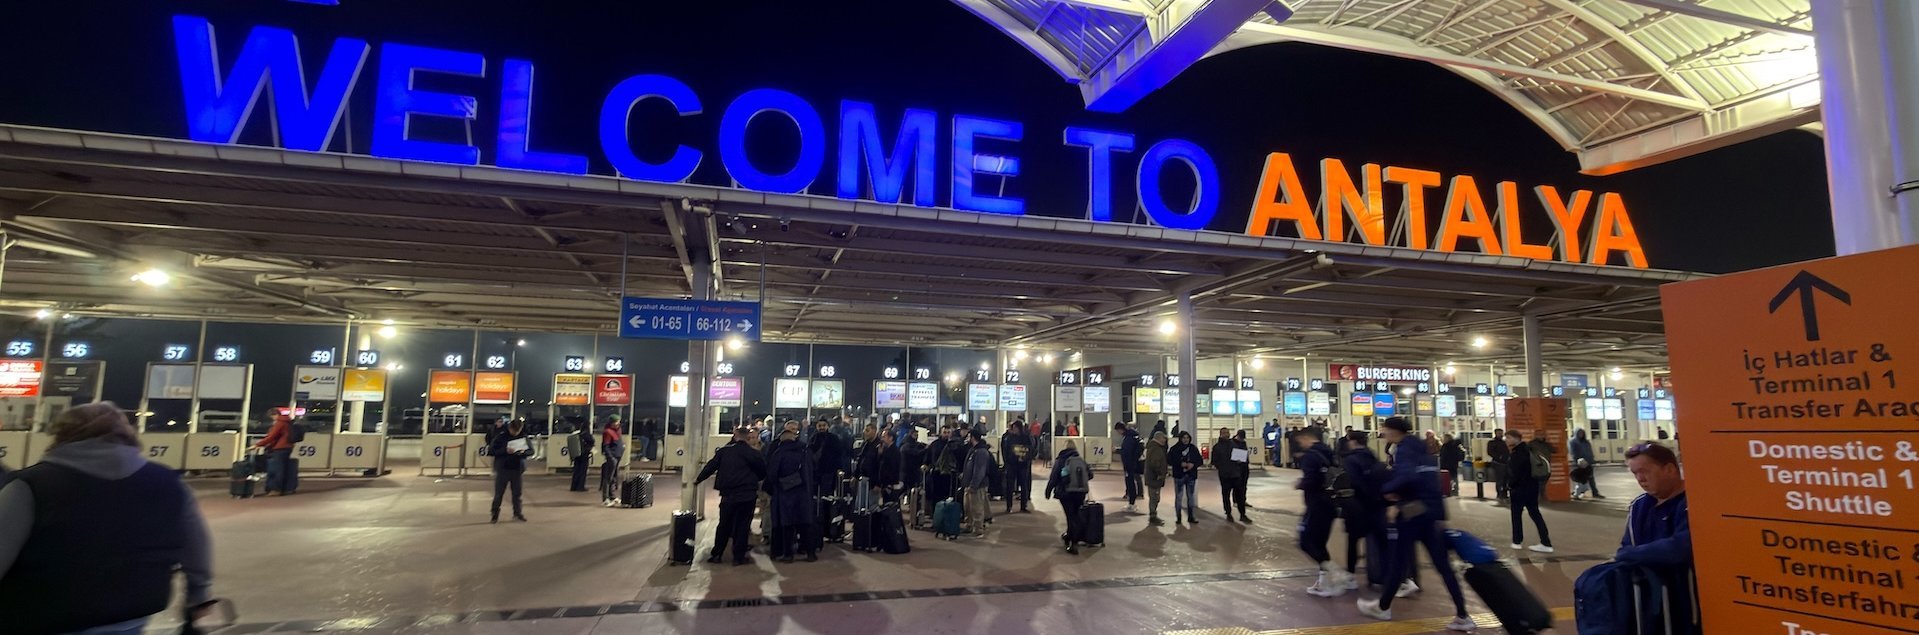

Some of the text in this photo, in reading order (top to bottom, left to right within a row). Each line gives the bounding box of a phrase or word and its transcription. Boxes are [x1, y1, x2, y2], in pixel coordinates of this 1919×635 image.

[172, 14, 1649, 268] WELCOME TO ANTALYA
[652, 315, 731, 332] 01-65 66-112
[6, 341, 32, 356] 55
[63, 343, 87, 357] 56
[164, 346, 187, 360] 57
[214, 347, 236, 361] 58
[311, 350, 331, 364] 59
[359, 352, 377, 364] 60
[444, 354, 462, 368] 61
[486, 356, 504, 369] 62
[1744, 343, 1892, 374] İç Hatlar &
[566, 358, 582, 370] 63
[606, 358, 622, 372] 64
[681, 361, 690, 373] 6
[717, 362, 733, 374] 66
[786, 364, 800, 376] 67
[820, 366, 834, 377] 68
[884, 367, 898, 378] 69
[916, 368, 930, 379] 70
[976, 370, 989, 380] 71
[1006, 371, 1019, 382] 72
[1358, 367, 1430, 381] BURGER KING
[1062, 372, 1074, 384] 73
[1090, 374, 1102, 384] 74
[1142, 374, 1154, 385] 75
[1218, 376, 1228, 387] 77
[1242, 378, 1253, 388] 78
[1749, 369, 1896, 395] Terminal 1
[1732, 400, 1844, 420] Transfer
[150, 446, 169, 457] 57
[202, 446, 220, 457] 58
[299, 446, 316, 457] 59
[346, 446, 363, 457] 60
[1094, 446, 1104, 456] 74
[1748, 440, 1919, 462] Domestic &
[1761, 465, 1914, 490] Terminal 1
[1786, 491, 1892, 516] Shuttle
[1761, 529, 1900, 561] Domestic
[1774, 556, 1904, 589] Terminal
